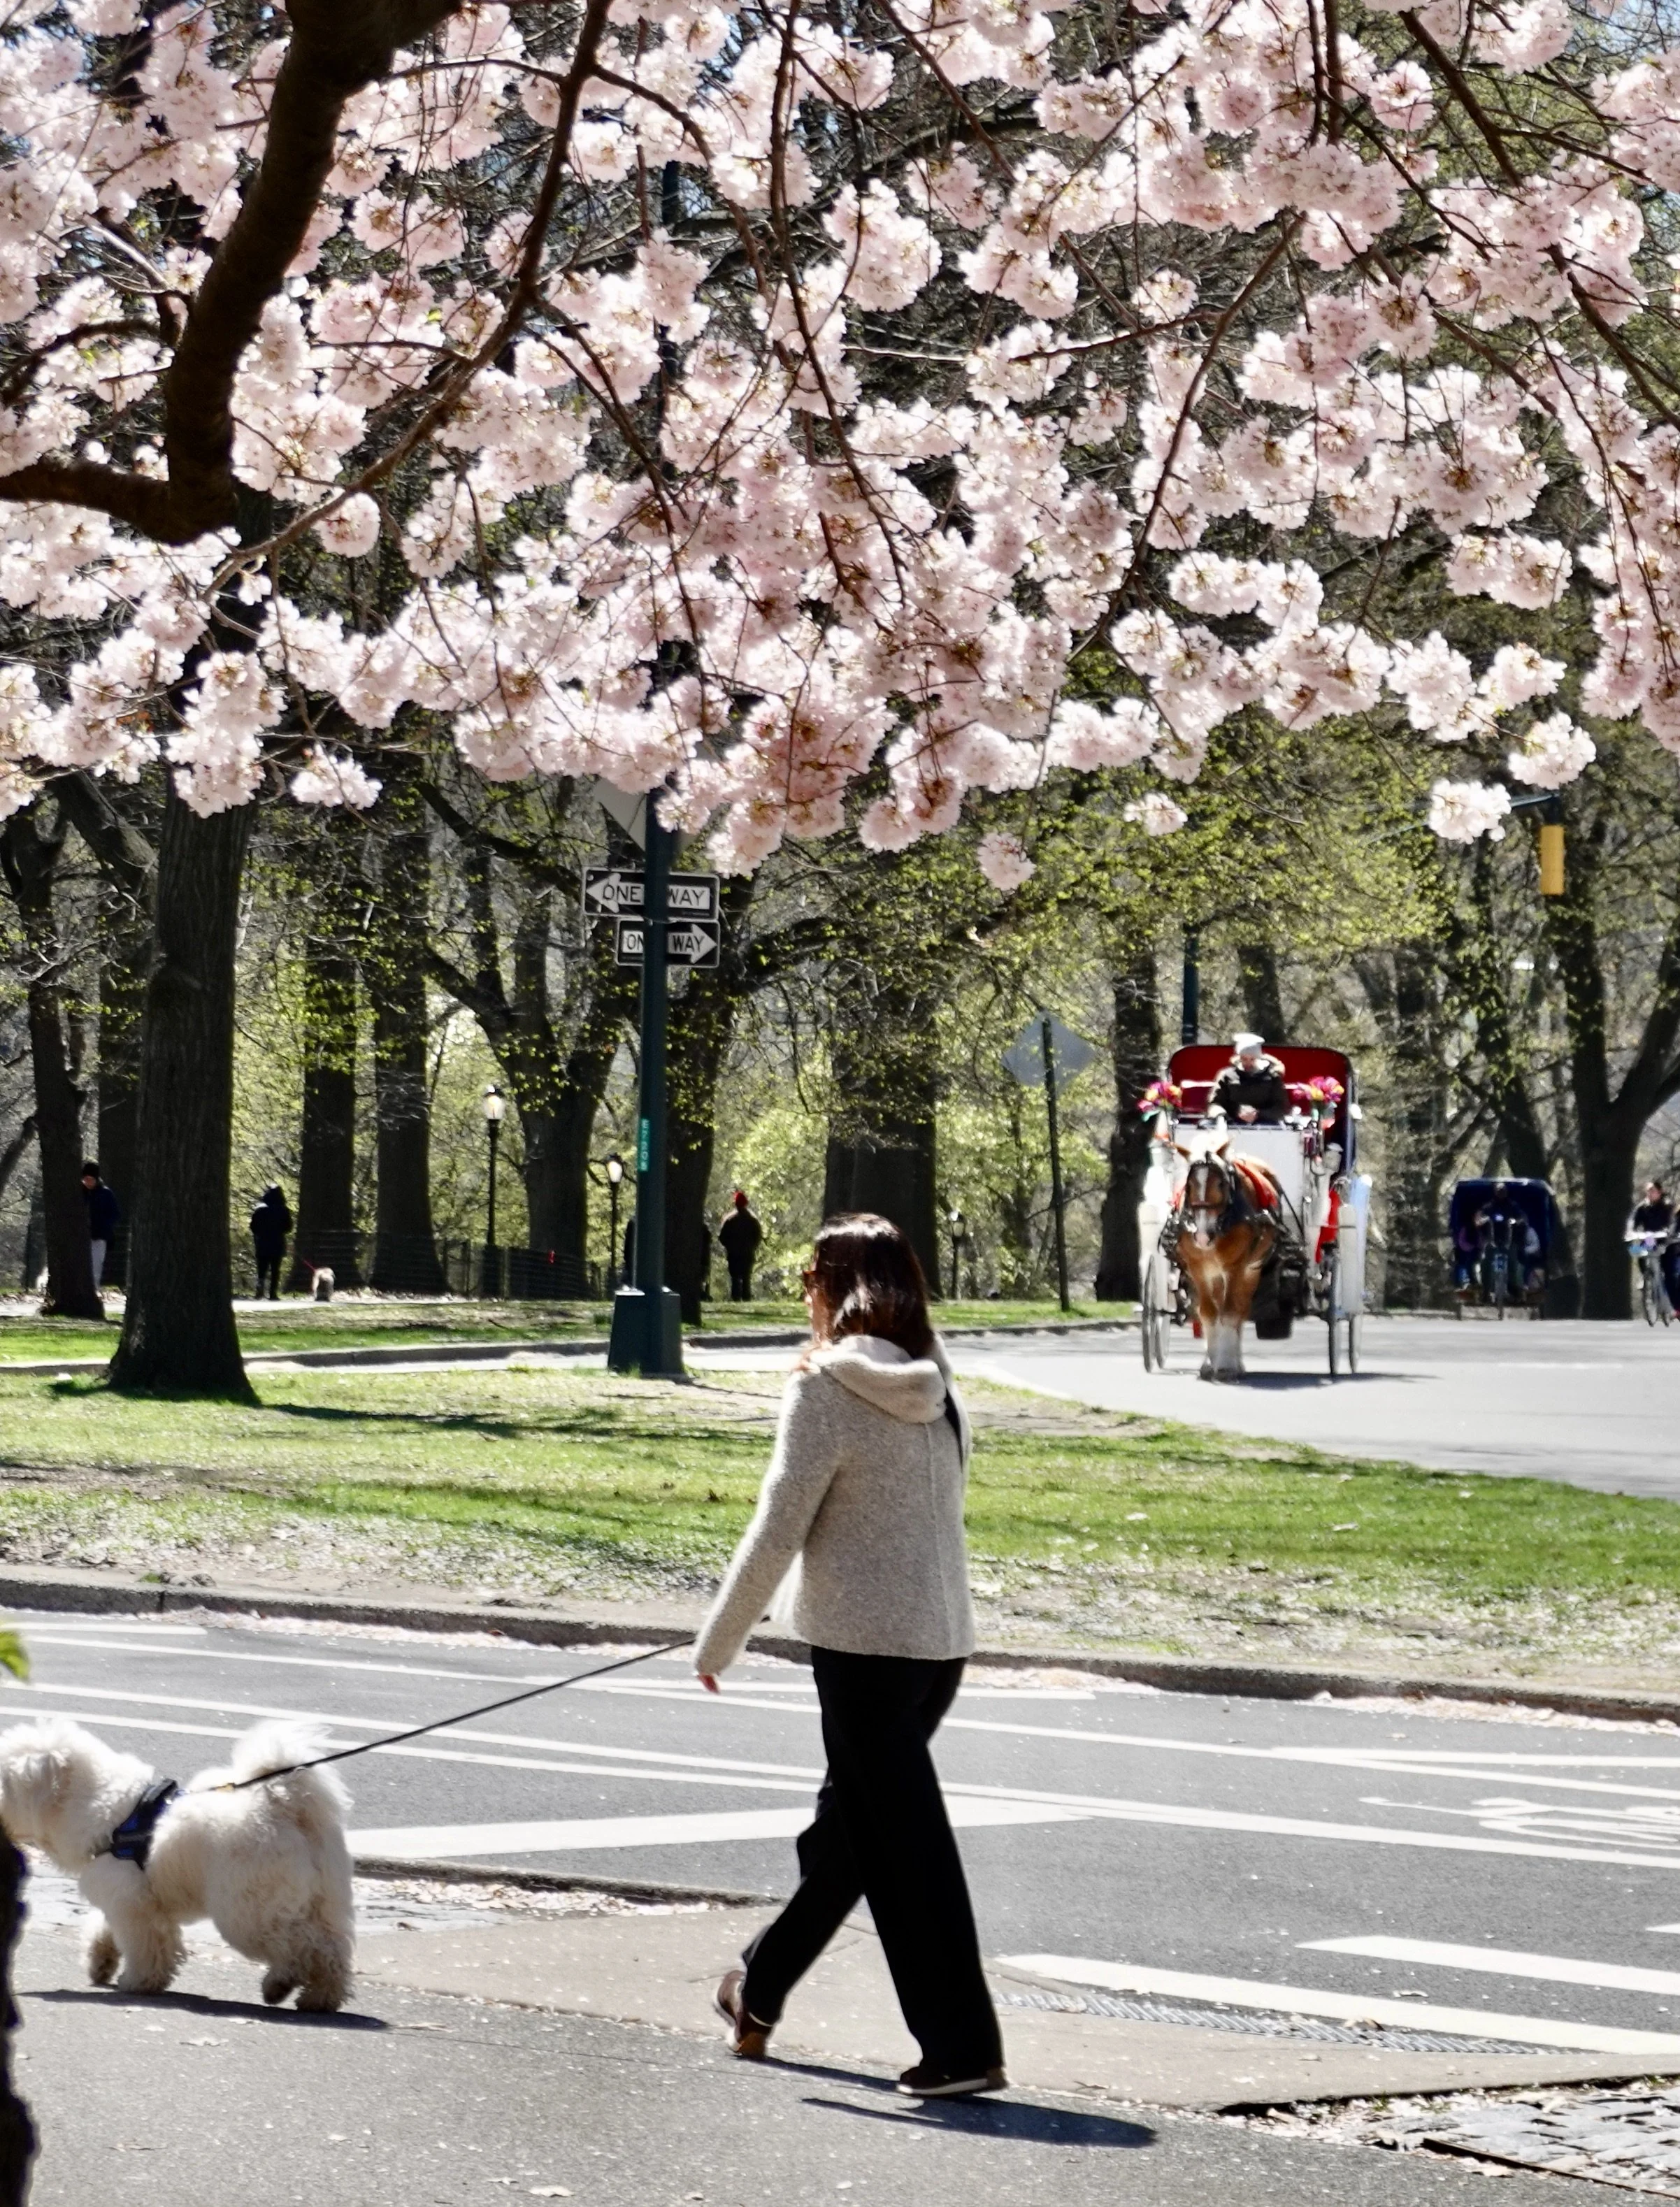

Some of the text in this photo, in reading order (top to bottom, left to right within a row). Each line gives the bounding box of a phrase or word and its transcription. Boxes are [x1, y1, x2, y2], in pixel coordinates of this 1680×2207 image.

[603, 884, 641, 903] ONE
[626, 933, 705, 953] ON WAY
